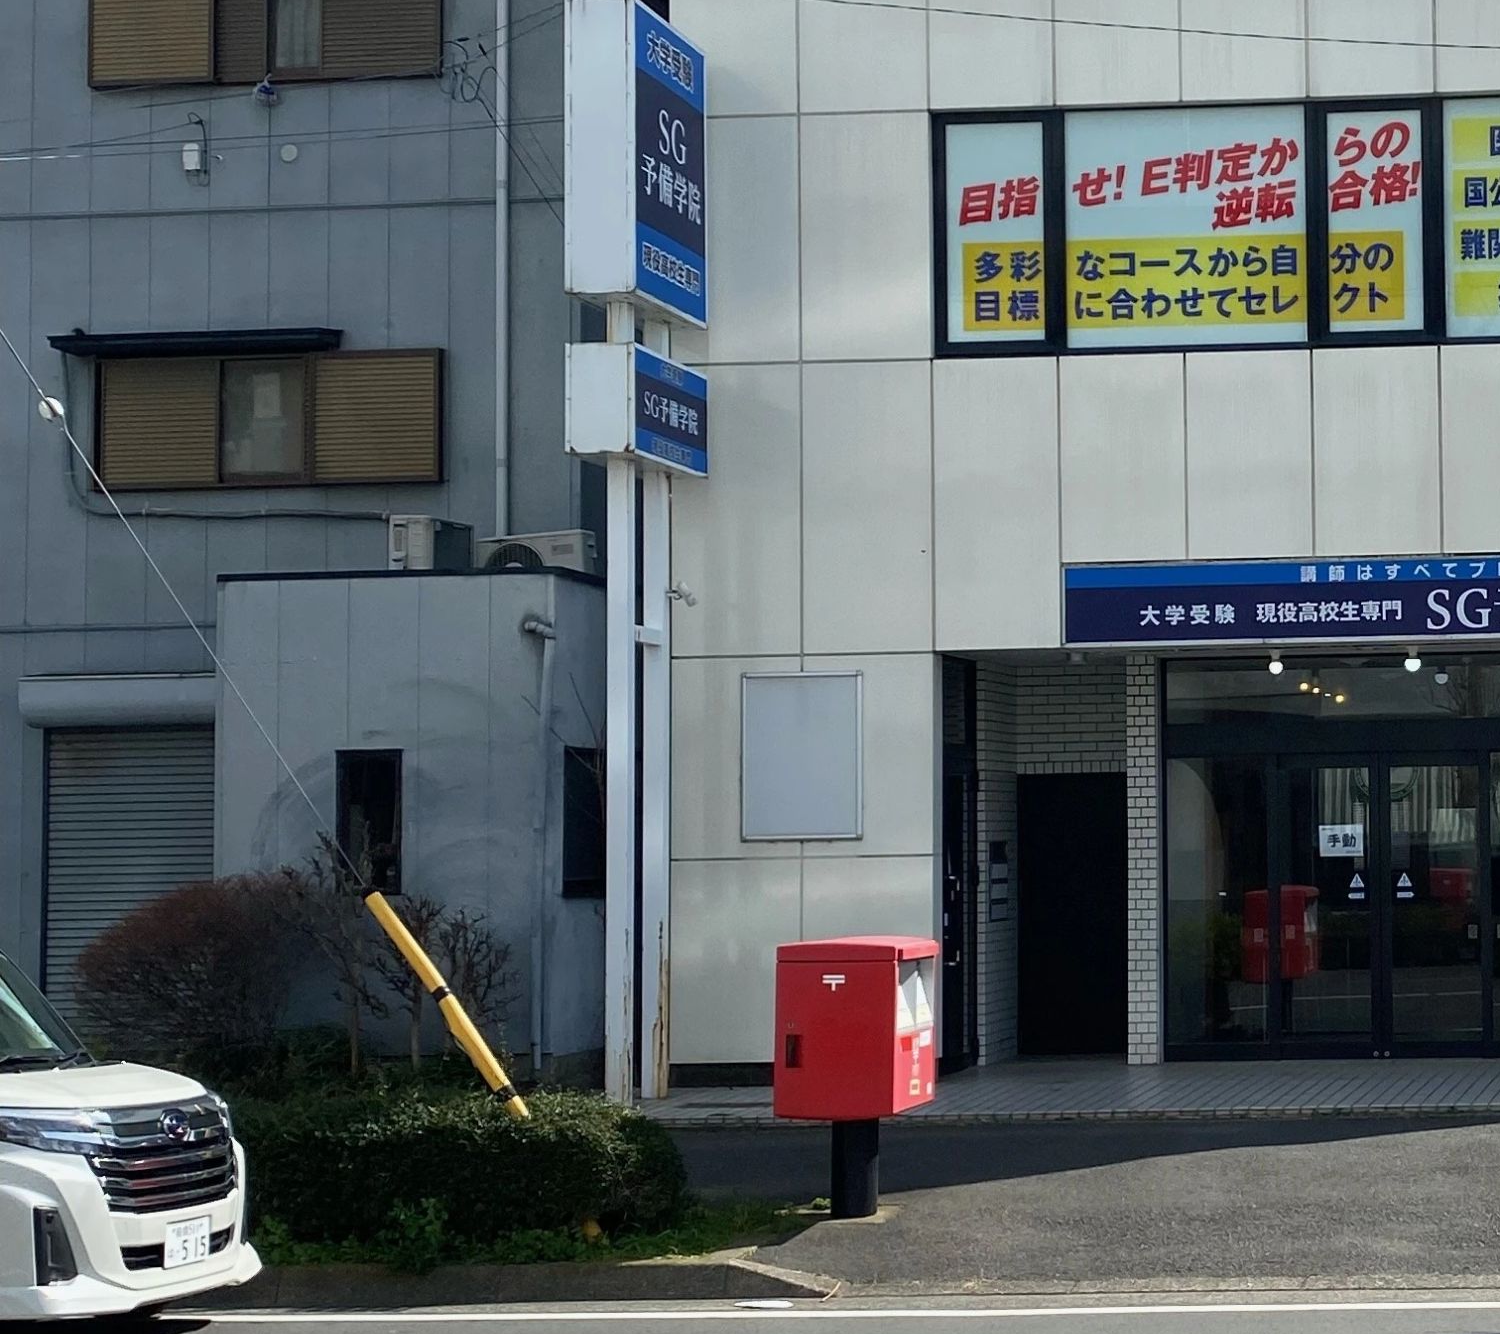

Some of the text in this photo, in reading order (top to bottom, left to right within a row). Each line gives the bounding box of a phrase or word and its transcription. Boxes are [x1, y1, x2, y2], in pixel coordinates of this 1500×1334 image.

[646, 29, 694, 95] 大学受験
[658, 107, 686, 166] SG
[640, 152, 702, 227] 予備学院
[643, 389, 699, 436] SG予備学院
[1139, 603, 1236, 627] 大学受験
[1255, 599, 1402, 624] 現役高校生専門
[1326, 832, 1357, 849] 手動
